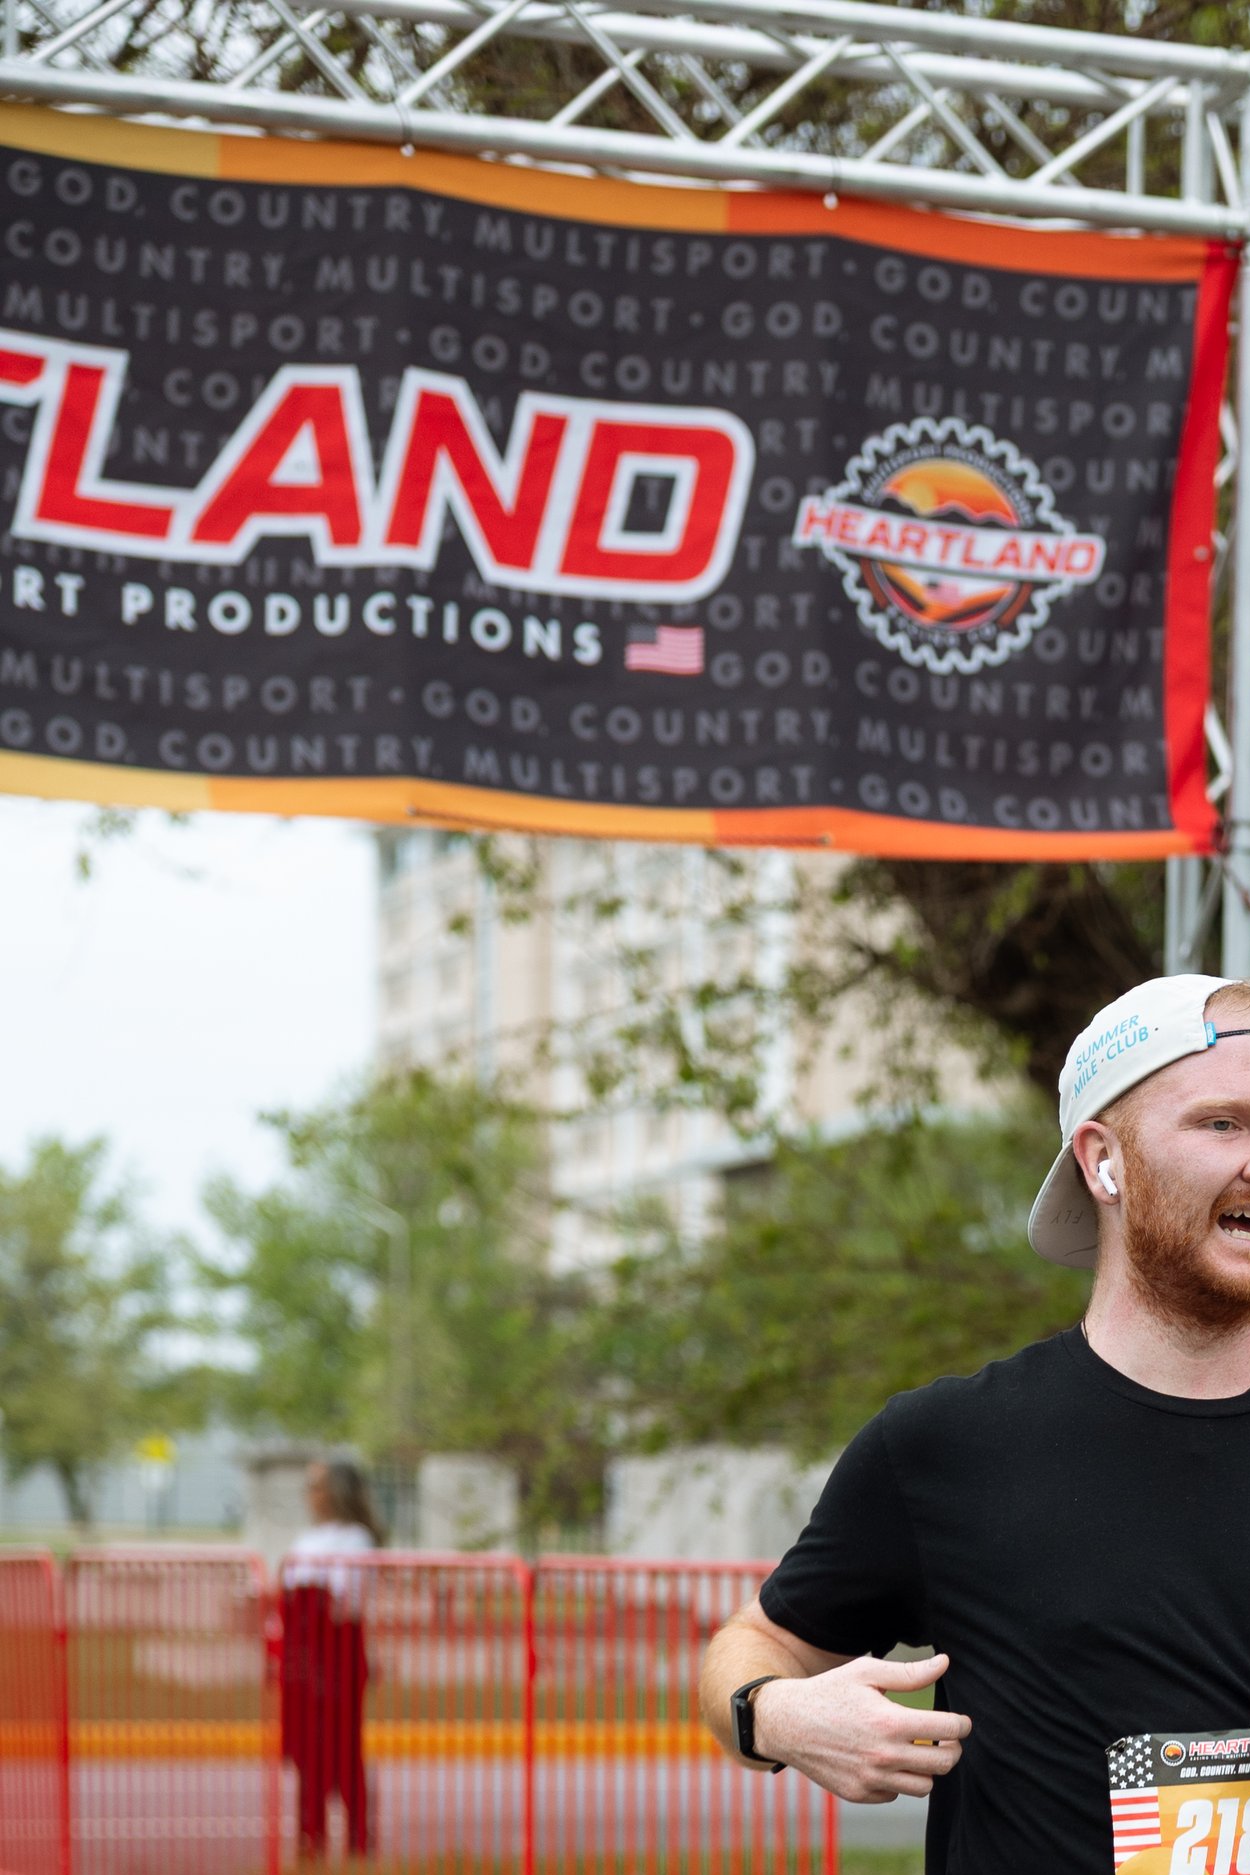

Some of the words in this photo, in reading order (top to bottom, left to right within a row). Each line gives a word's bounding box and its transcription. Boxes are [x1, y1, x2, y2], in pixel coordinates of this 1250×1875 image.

[475, 214, 829, 279] MULTISPORT
[2, 283, 379, 354] MULTISPORT
[316, 257, 675, 333] MULTISPORT
[802, 503, 1097, 575] HEARTLAND
[0, 564, 85, 617] RT
[121, 582, 604, 666] PRODUCTIONS
[0, 648, 371, 715] MULTISPORT
[857, 717, 1168, 777] MULTISPOR
[465, 745, 816, 801] MULTISPORT
[1074, 1059, 1098, 1099] MILE
[1106, 1026, 1149, 1060] CLUB
[1076, 1015, 1139, 1071] SUMMER
[1200, 1764, 1236, 1777] COUNTRY.
